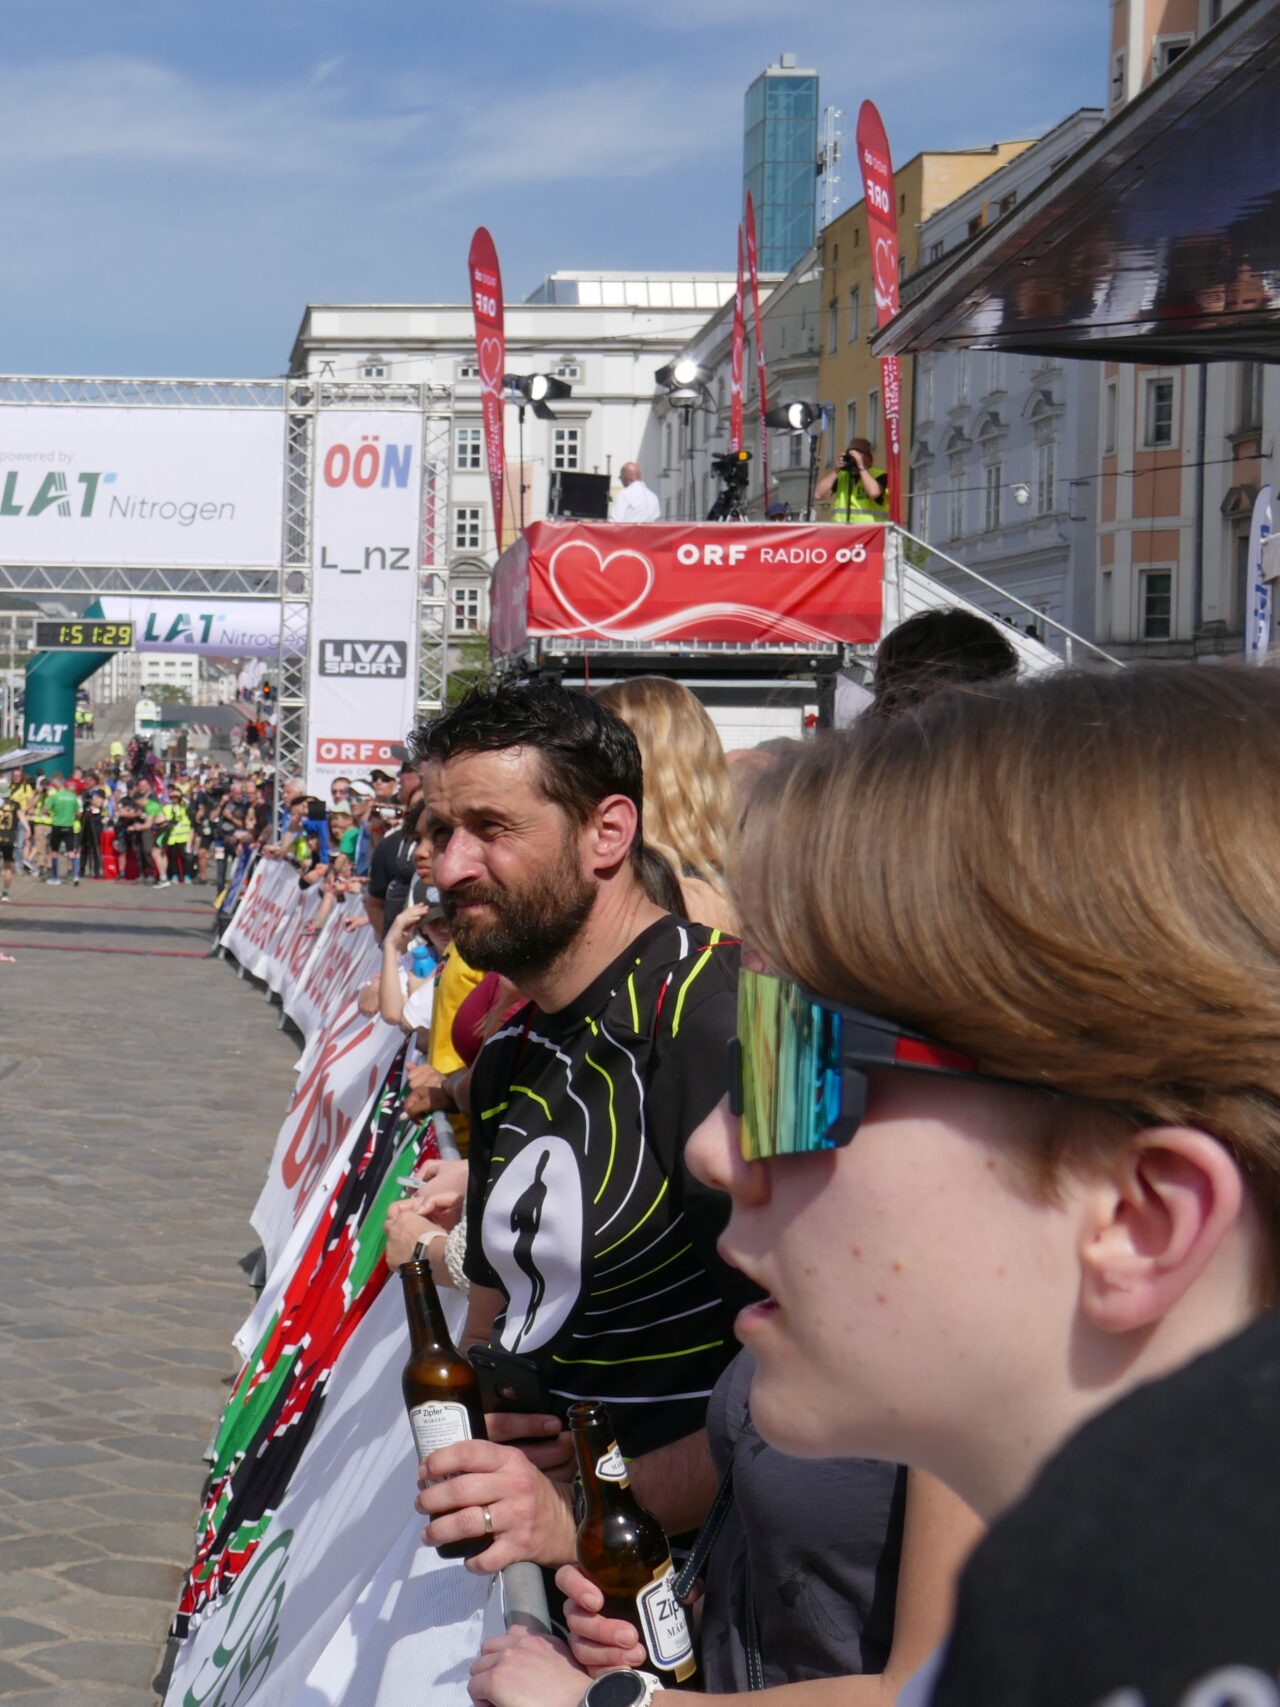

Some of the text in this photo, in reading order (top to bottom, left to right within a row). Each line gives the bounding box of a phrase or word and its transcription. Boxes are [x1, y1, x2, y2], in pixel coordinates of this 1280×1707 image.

[0, 450, 74, 464] powered by
[323, 435, 413, 488] OÖN
[0, 471, 236, 527] LAT Nitrogen
[677, 543, 748, 566] ORF
[760, 548, 827, 564] RADIO
[144, 612, 215, 644] LAT
[324, 643, 402, 663] LIVA
[324, 662, 402, 675] SPORT
[28, 723, 63, 743] LAT
[320, 743, 374, 760] ORF
[423, 1409, 443, 1417] Zipfer
[656, 1598, 680, 1622] Zip
